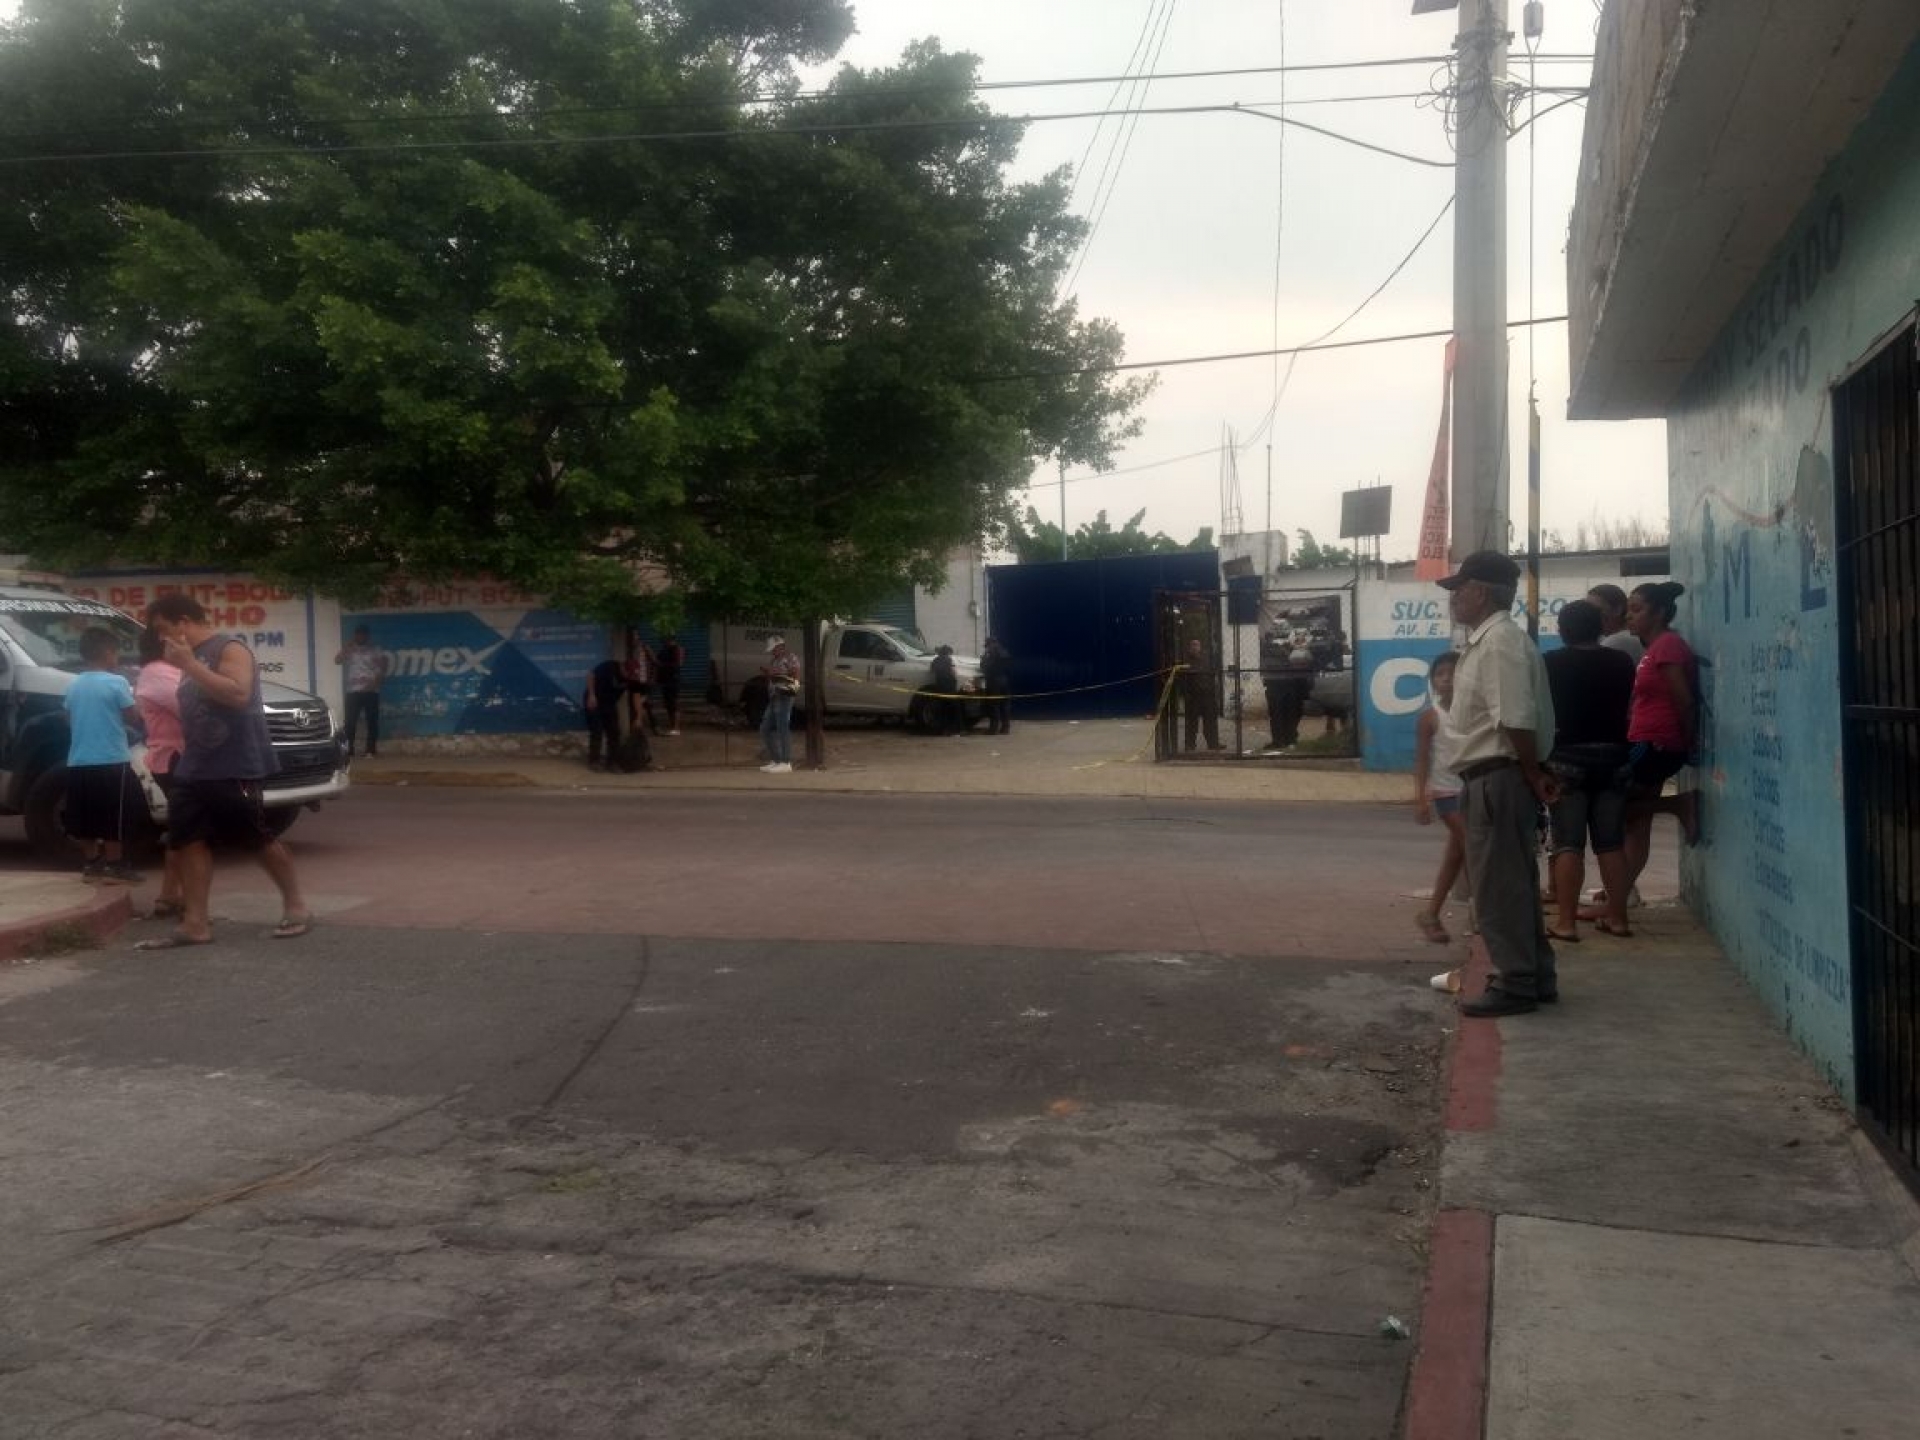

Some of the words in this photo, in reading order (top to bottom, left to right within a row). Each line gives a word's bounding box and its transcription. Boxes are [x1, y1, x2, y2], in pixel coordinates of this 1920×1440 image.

[109, 586, 146, 607] DE
[1391, 600, 1443, 621] SUC.
[1395, 622, 1420, 637] AV.
[254, 631, 285, 648] PM
